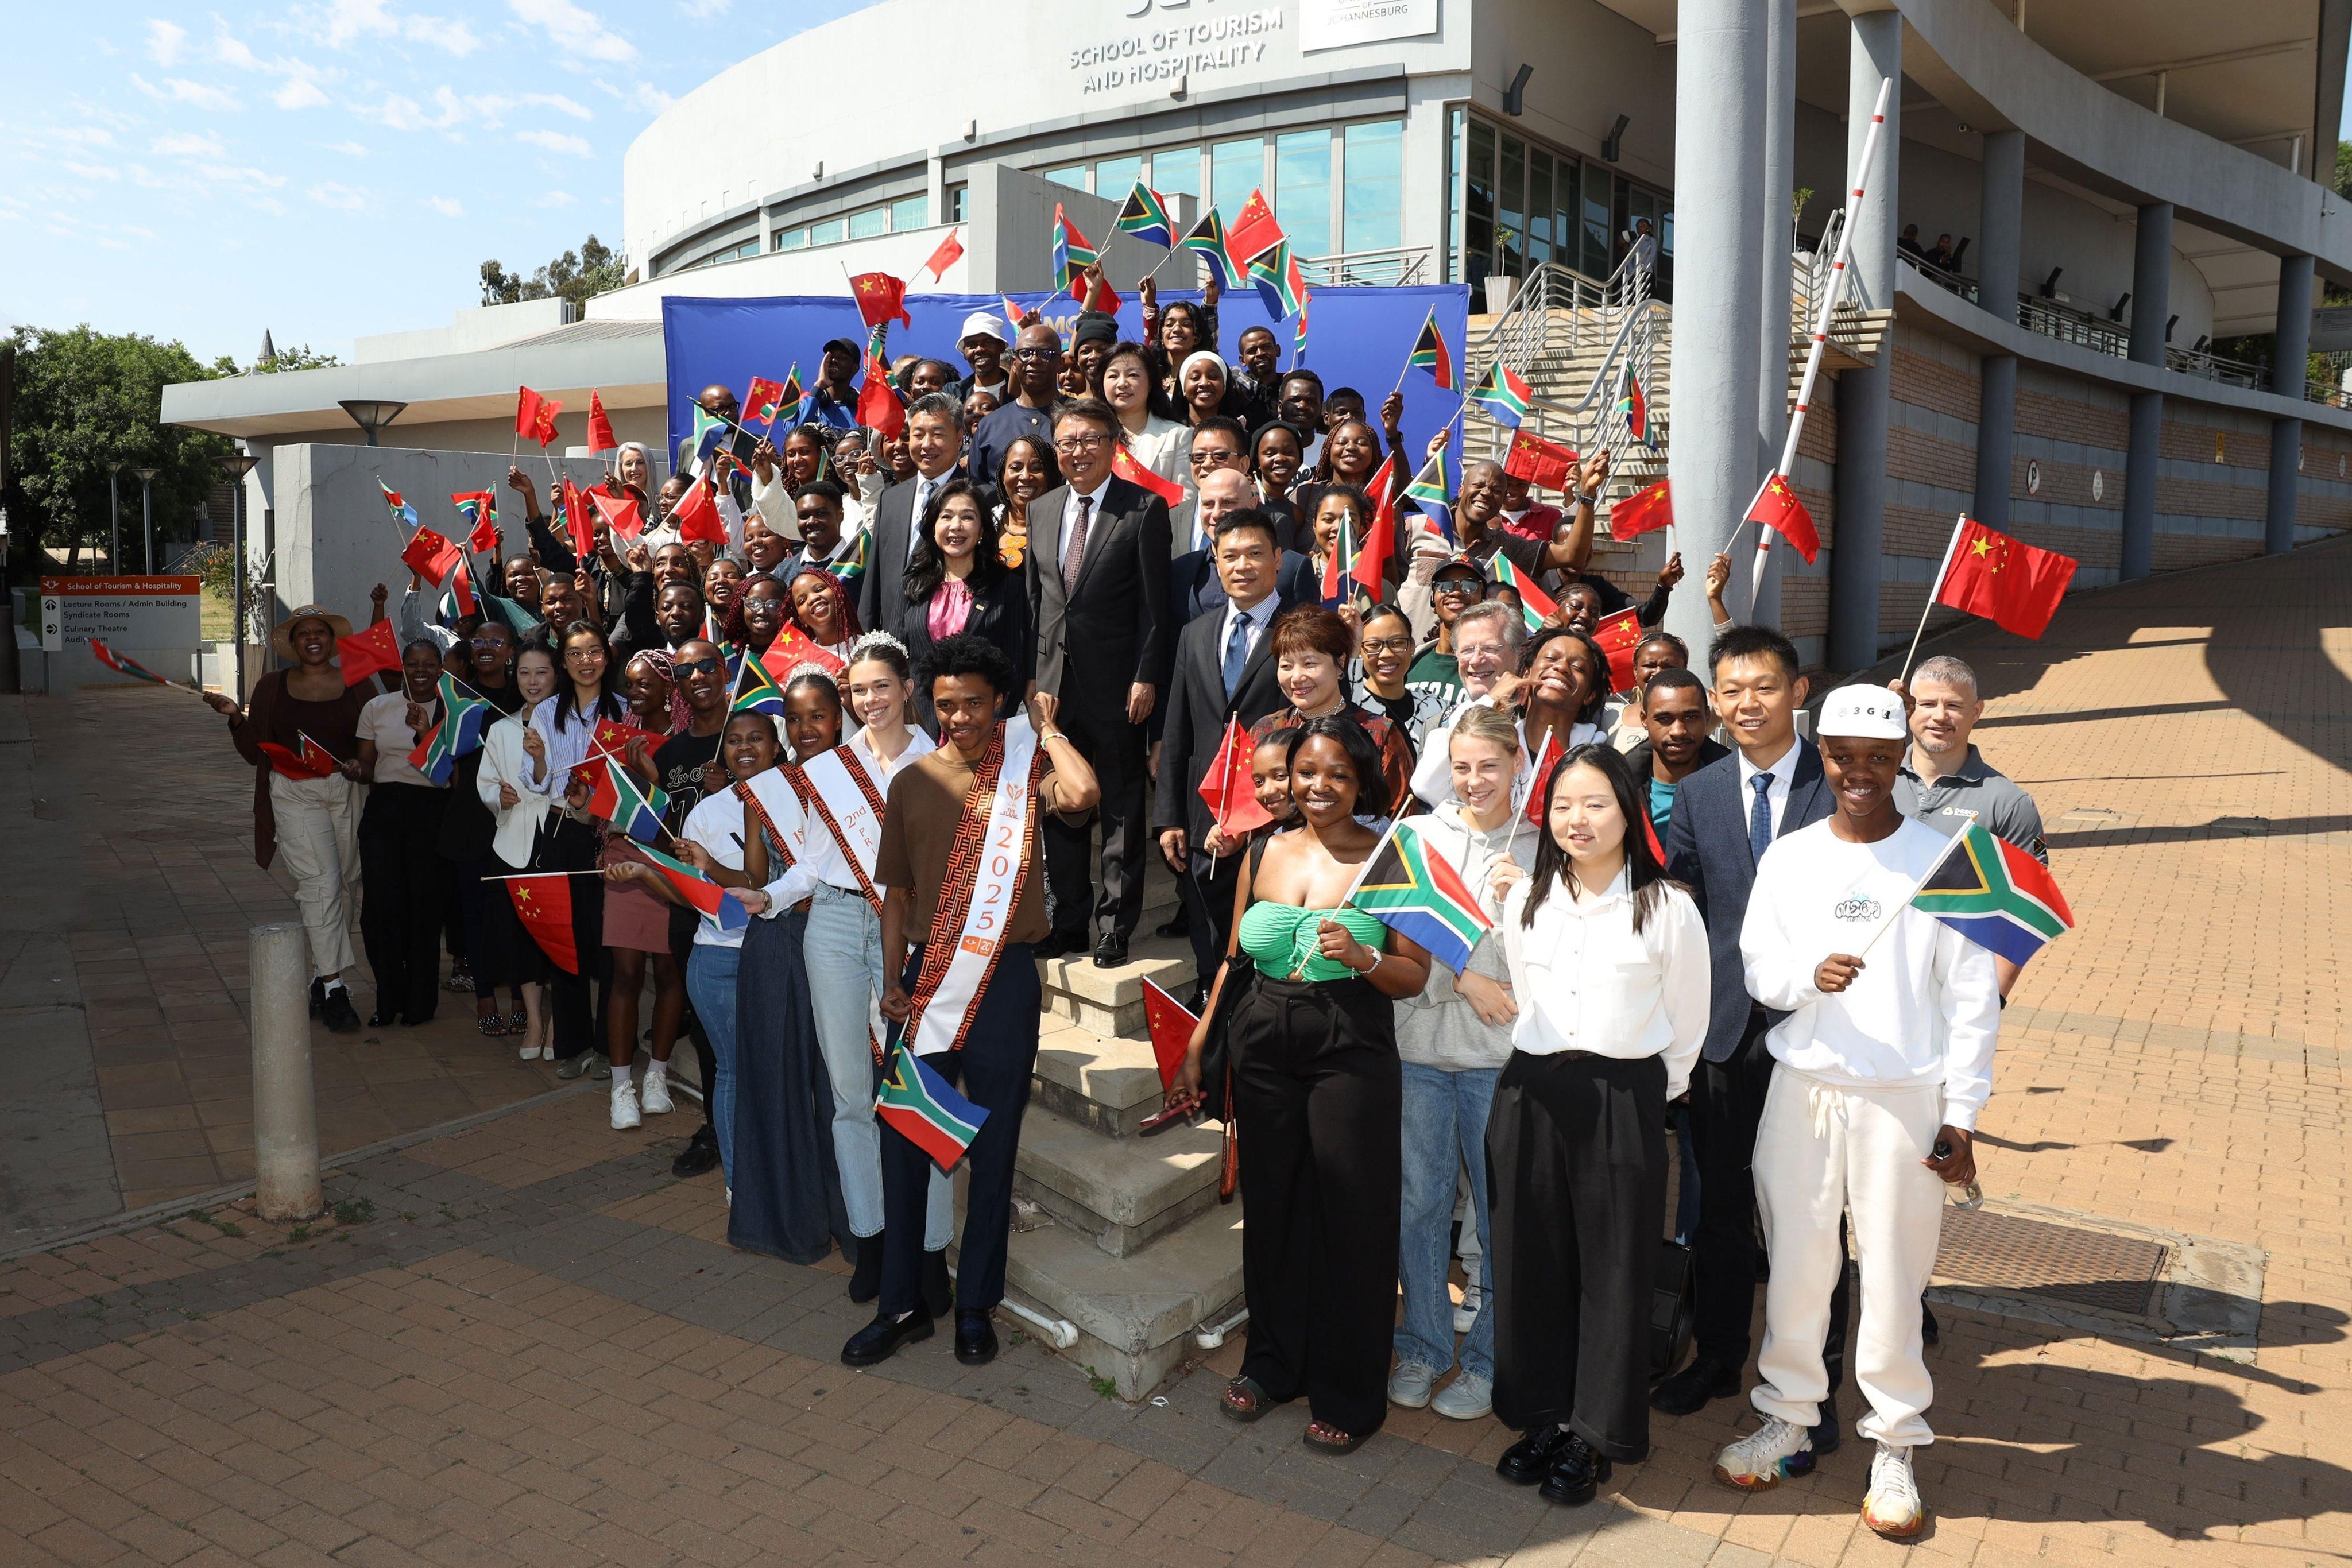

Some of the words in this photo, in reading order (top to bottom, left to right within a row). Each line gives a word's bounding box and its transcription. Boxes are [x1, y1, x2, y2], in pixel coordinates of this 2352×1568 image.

[1327, 5, 1408, 25] JOHANNESBURG
[1070, 37, 1147, 69] SCHOOL
[1151, 27, 1179, 52] OF
[1183, 6, 1283, 46] TOURISM
[1084, 67, 1124, 95] AND
[1129, 38, 1267, 86] HOSPITALITY
[142, 582, 181, 590] Hospitality
[156, 600, 187, 609] Building
[64, 611, 101, 620] Syndicate
[64, 625, 95, 633] Culinary
[667, 765, 688, 788] Los
[844, 805, 866, 830] 2nd
[792, 826, 804, 846] 1s
[976, 826, 1013, 930] 2025
